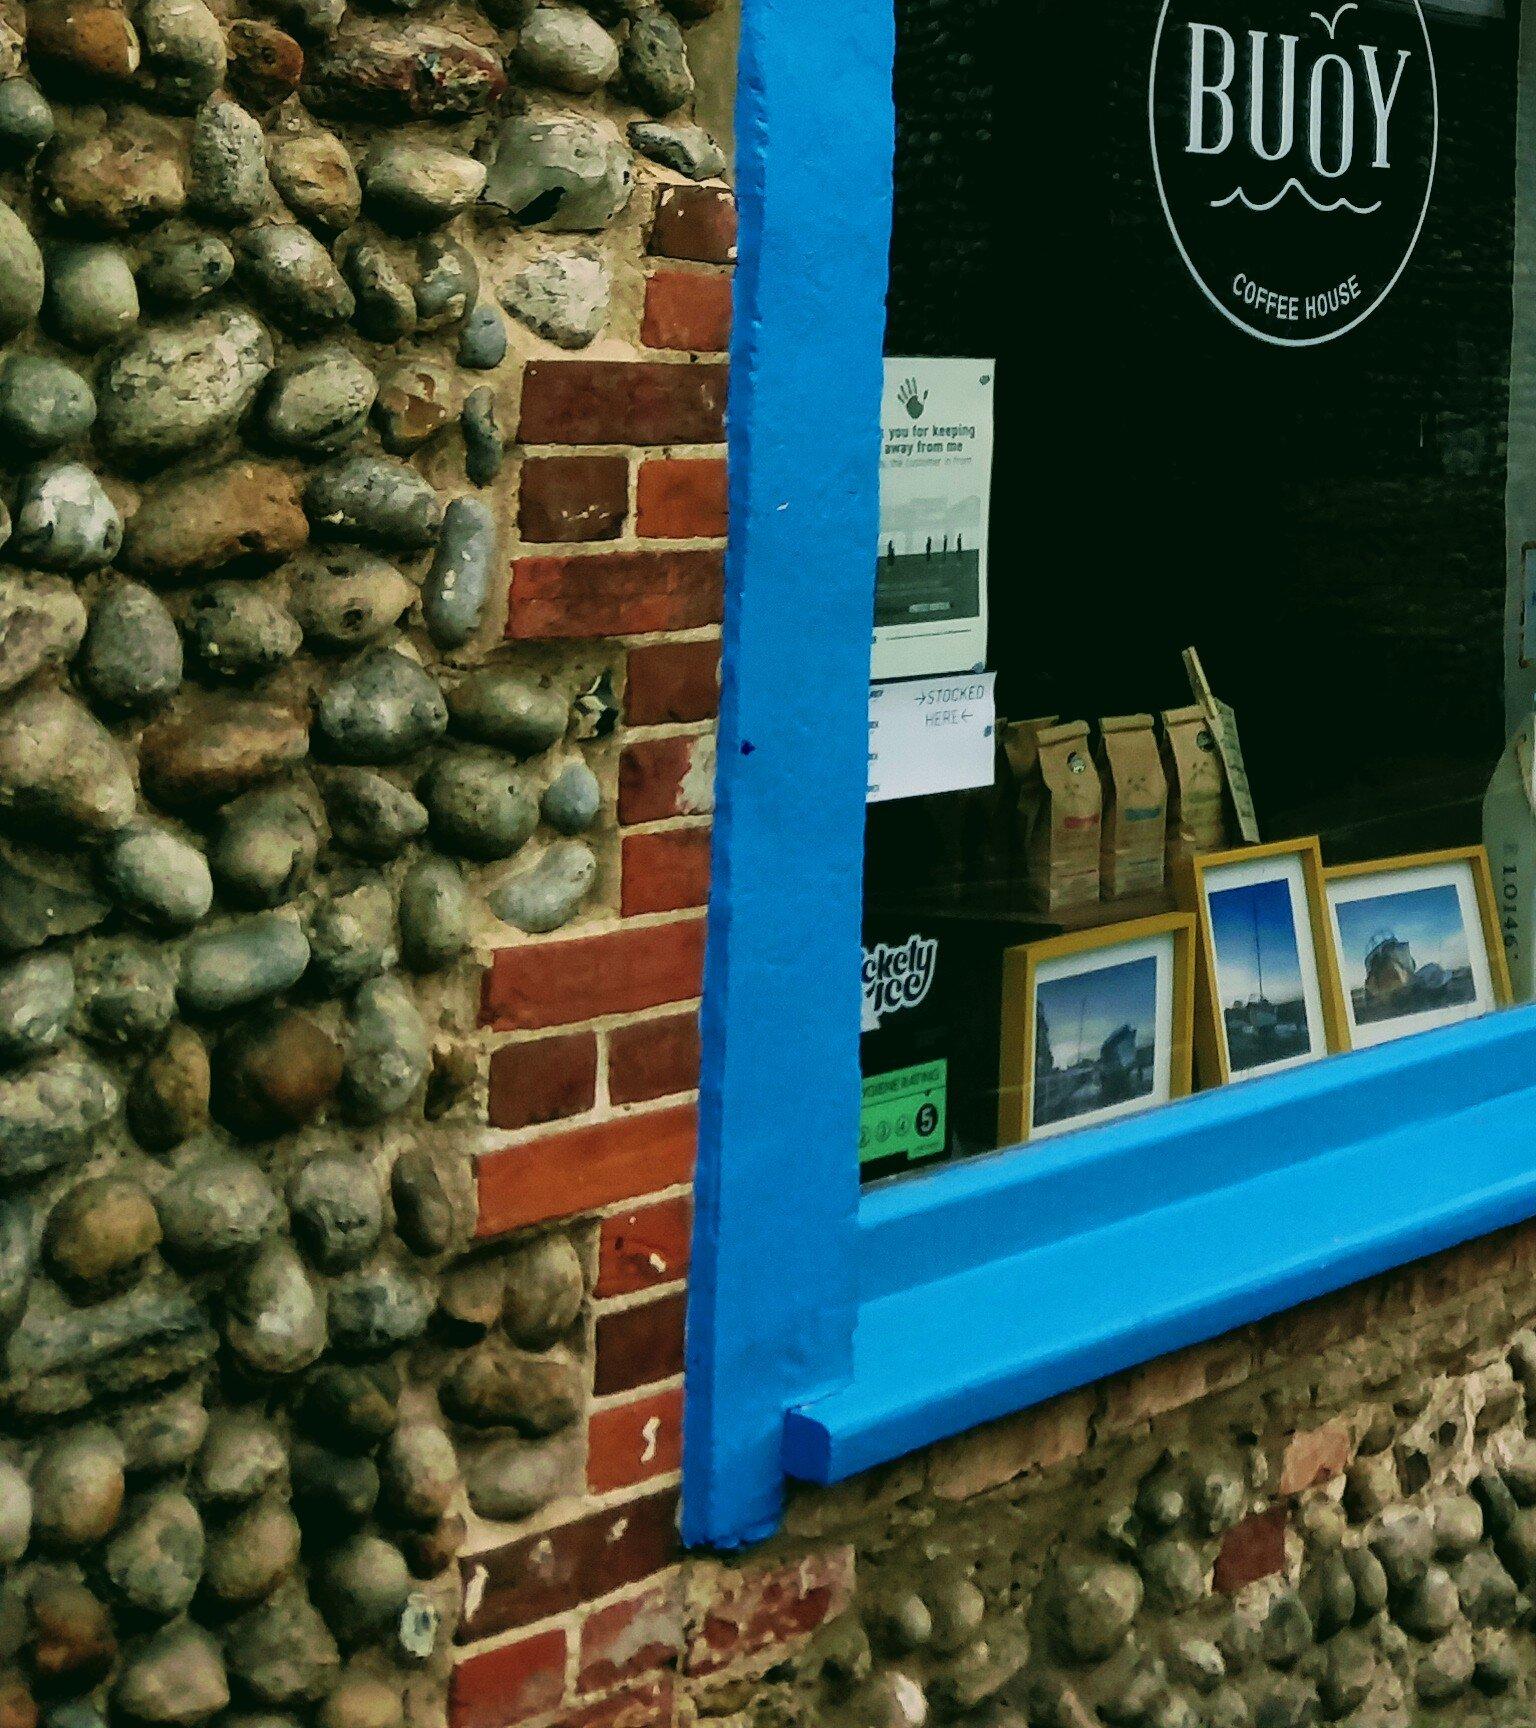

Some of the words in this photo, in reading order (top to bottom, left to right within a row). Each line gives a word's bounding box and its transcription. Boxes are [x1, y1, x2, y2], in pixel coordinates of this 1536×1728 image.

[1184, 21, 1412, 178] BUOY
[1231, 272, 1300, 321] COFFEE
[1304, 273, 1362, 320] HOUSE
[888, 427, 909, 441] you
[912, 424, 929, 438] for
[932, 423, 976, 440] keeping
[884, 443, 913, 457] away
[917, 440, 943, 453] from
[946, 441, 963, 453] me
[928, 684, 985, 705] STOCKED
[925, 709, 958, 728] HERE
